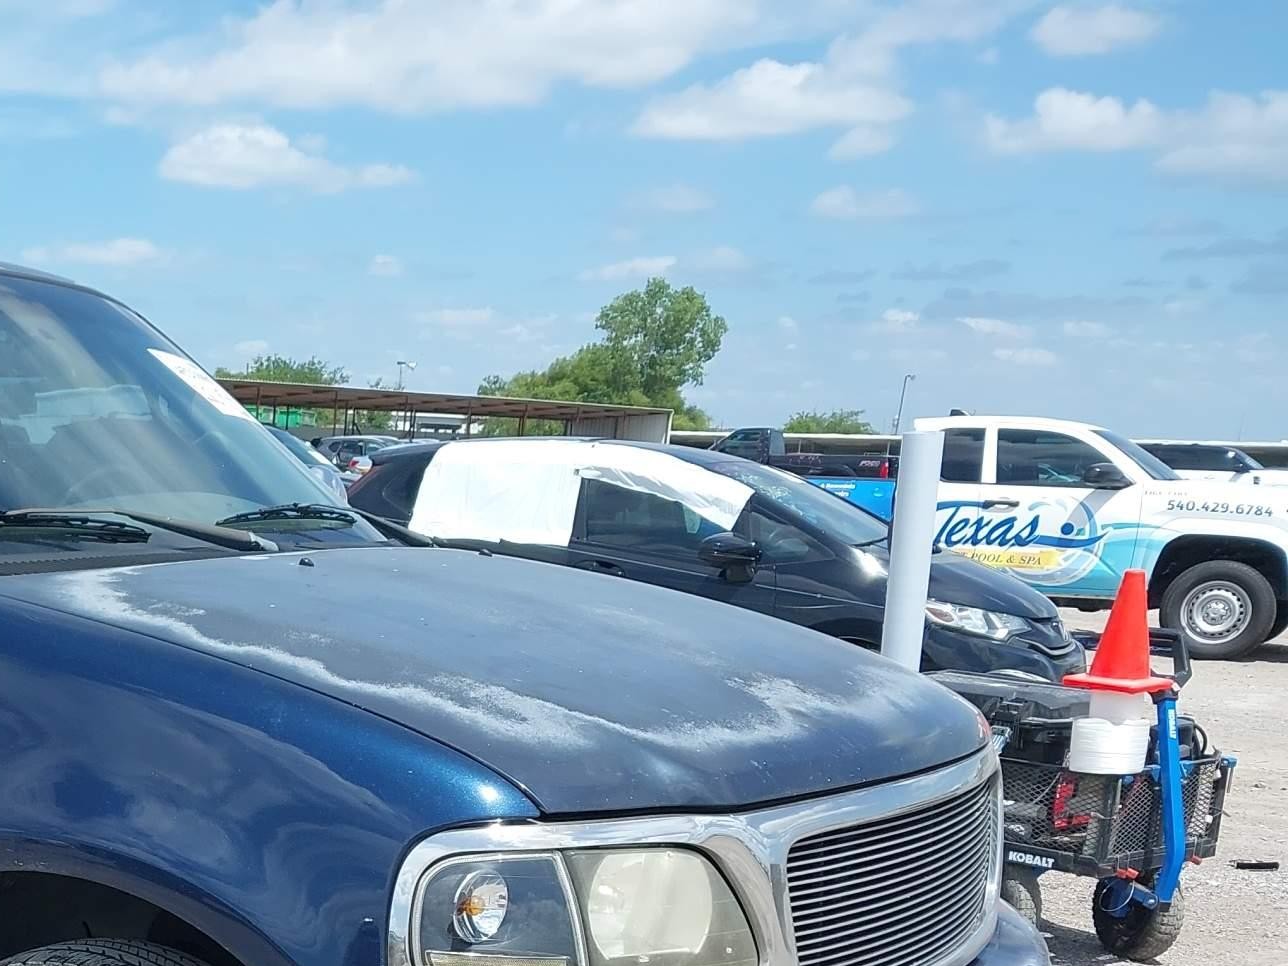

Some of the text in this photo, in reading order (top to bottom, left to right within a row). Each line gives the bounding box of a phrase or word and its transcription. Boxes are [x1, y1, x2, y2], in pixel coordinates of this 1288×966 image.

[1167, 500, 1273, 517] 540.429.6784
[933, 500, 1040, 547] Texas
[970, 552, 1003, 563] POOL
[1006, 555, 1015, 564] &
[1018, 555, 1042, 566] SPA
[1008, 851, 1055, 868] KOBALT
